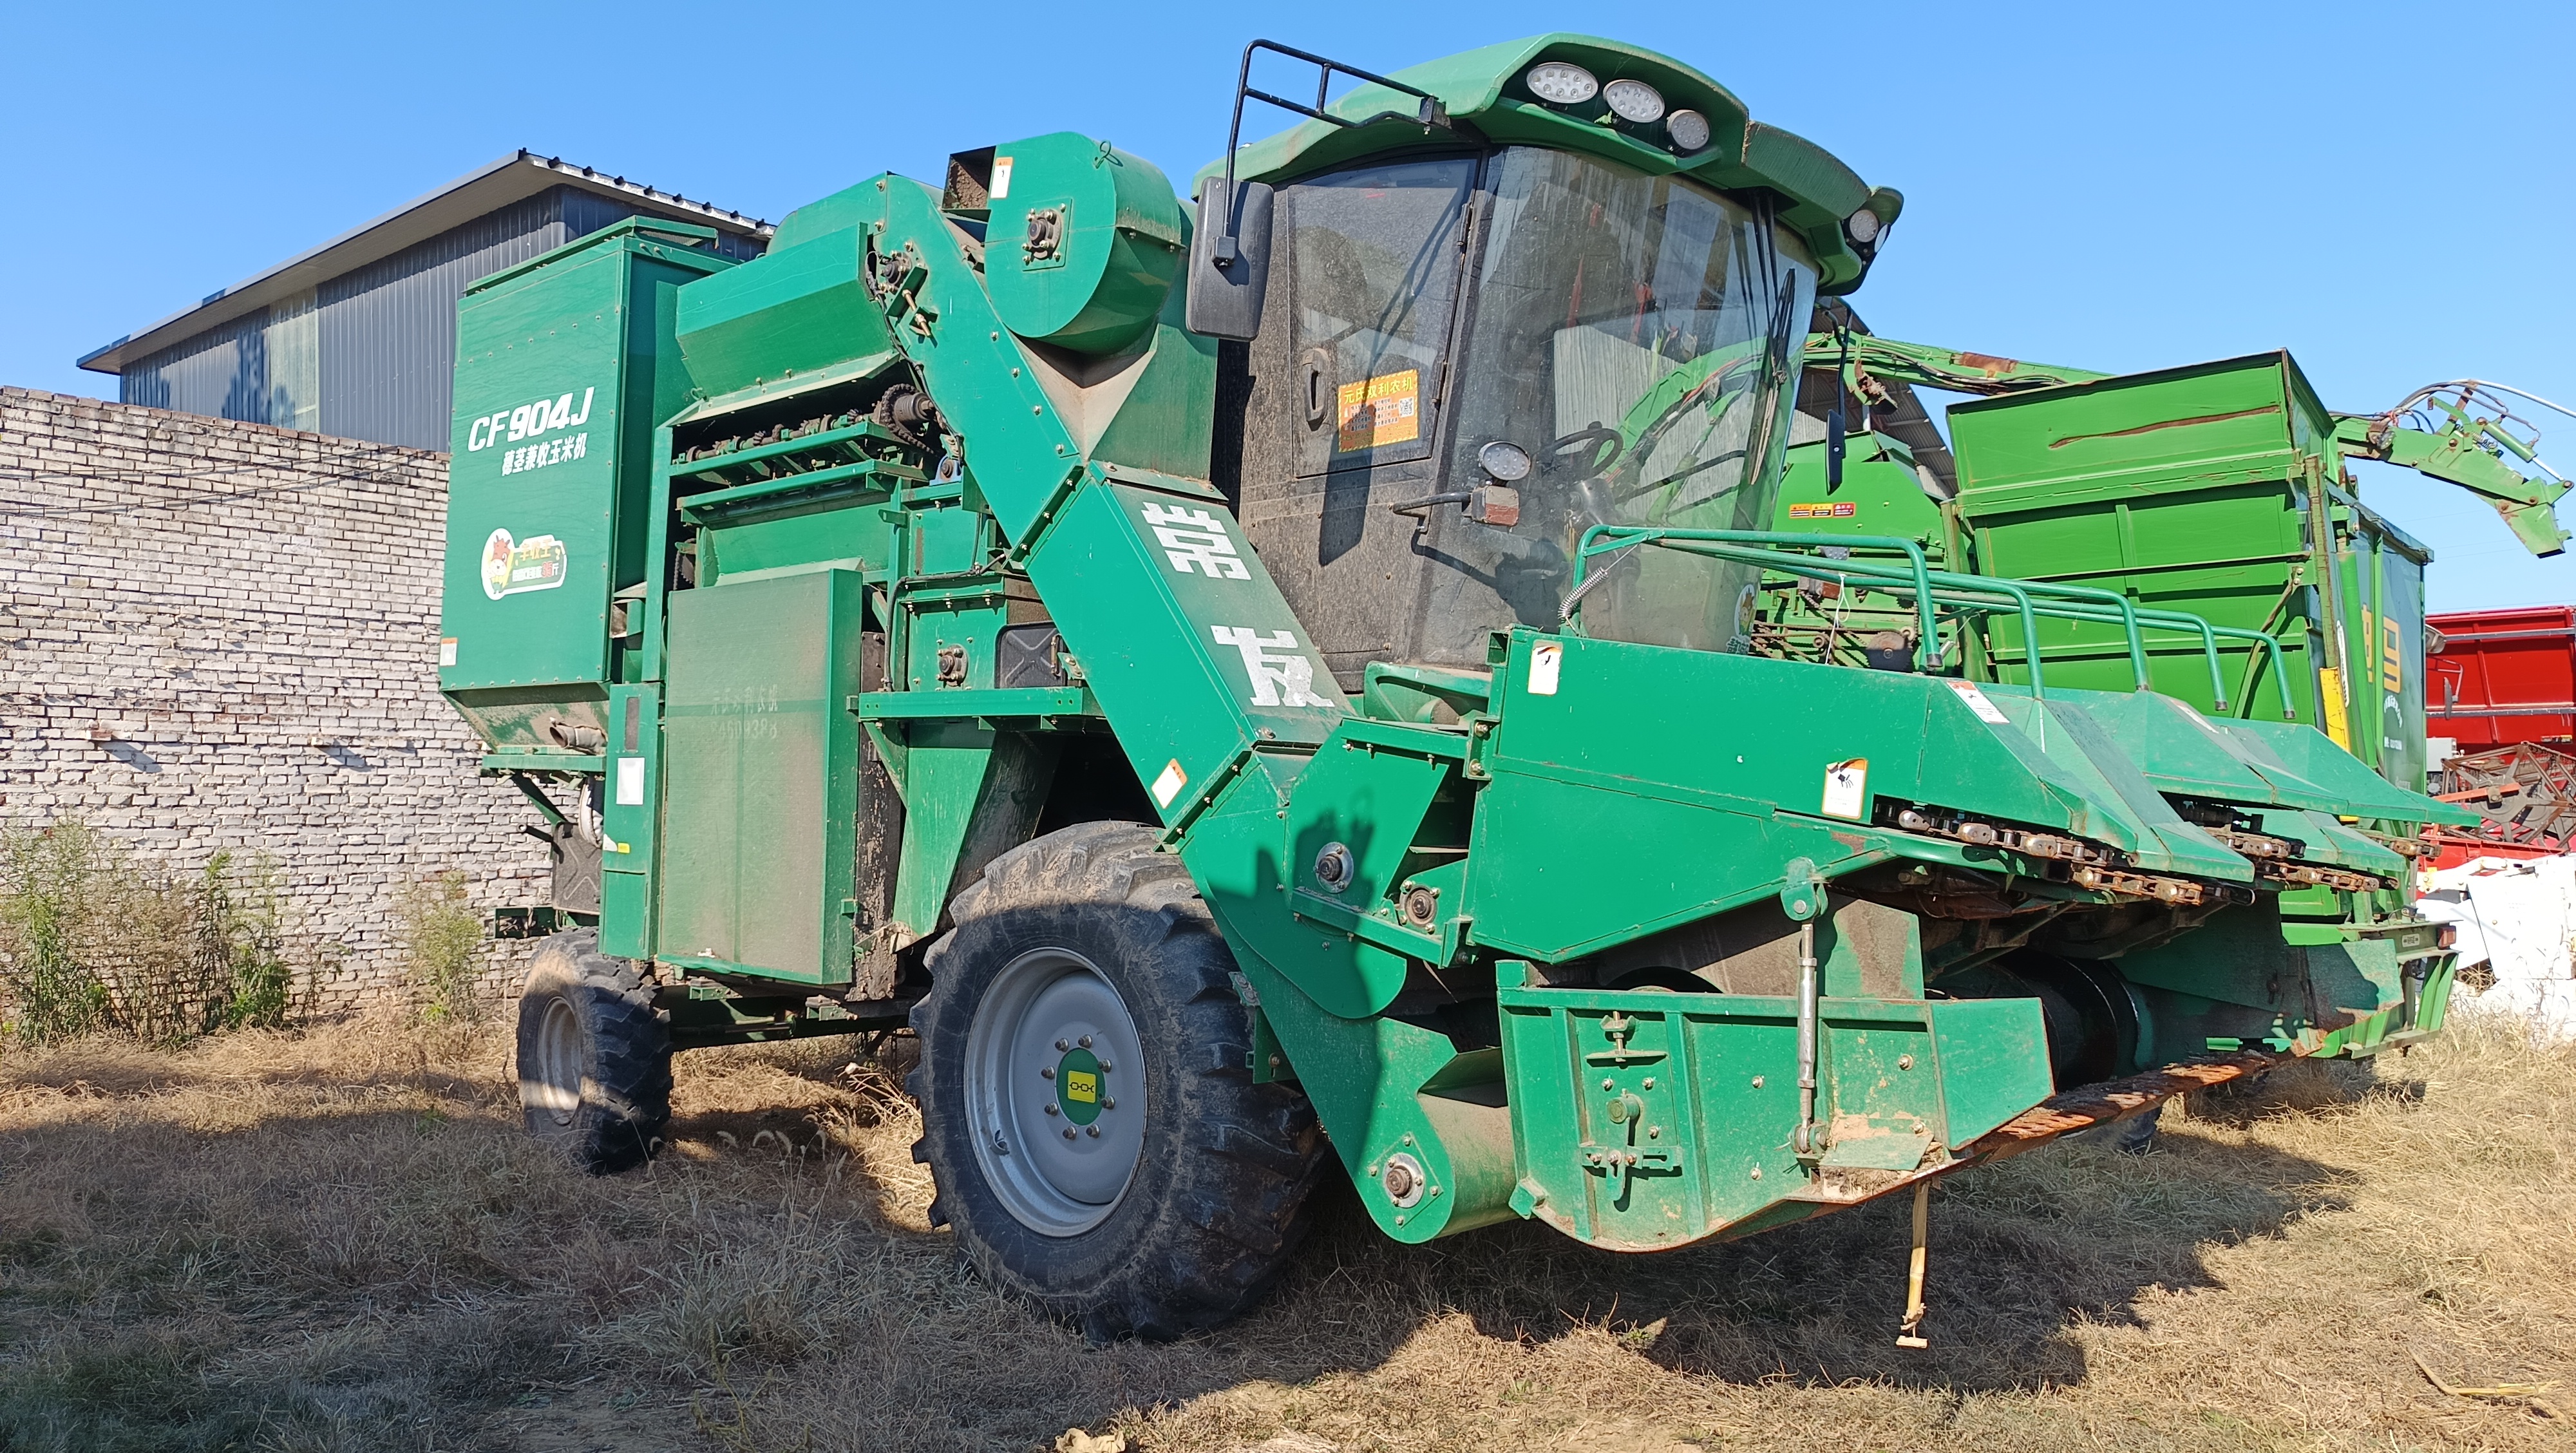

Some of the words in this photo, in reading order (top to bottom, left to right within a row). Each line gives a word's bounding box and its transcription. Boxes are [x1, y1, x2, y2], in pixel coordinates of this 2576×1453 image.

[1344, 376, 1414, 404] 元氏双利农机
[468, 386, 594, 451] CF904J
